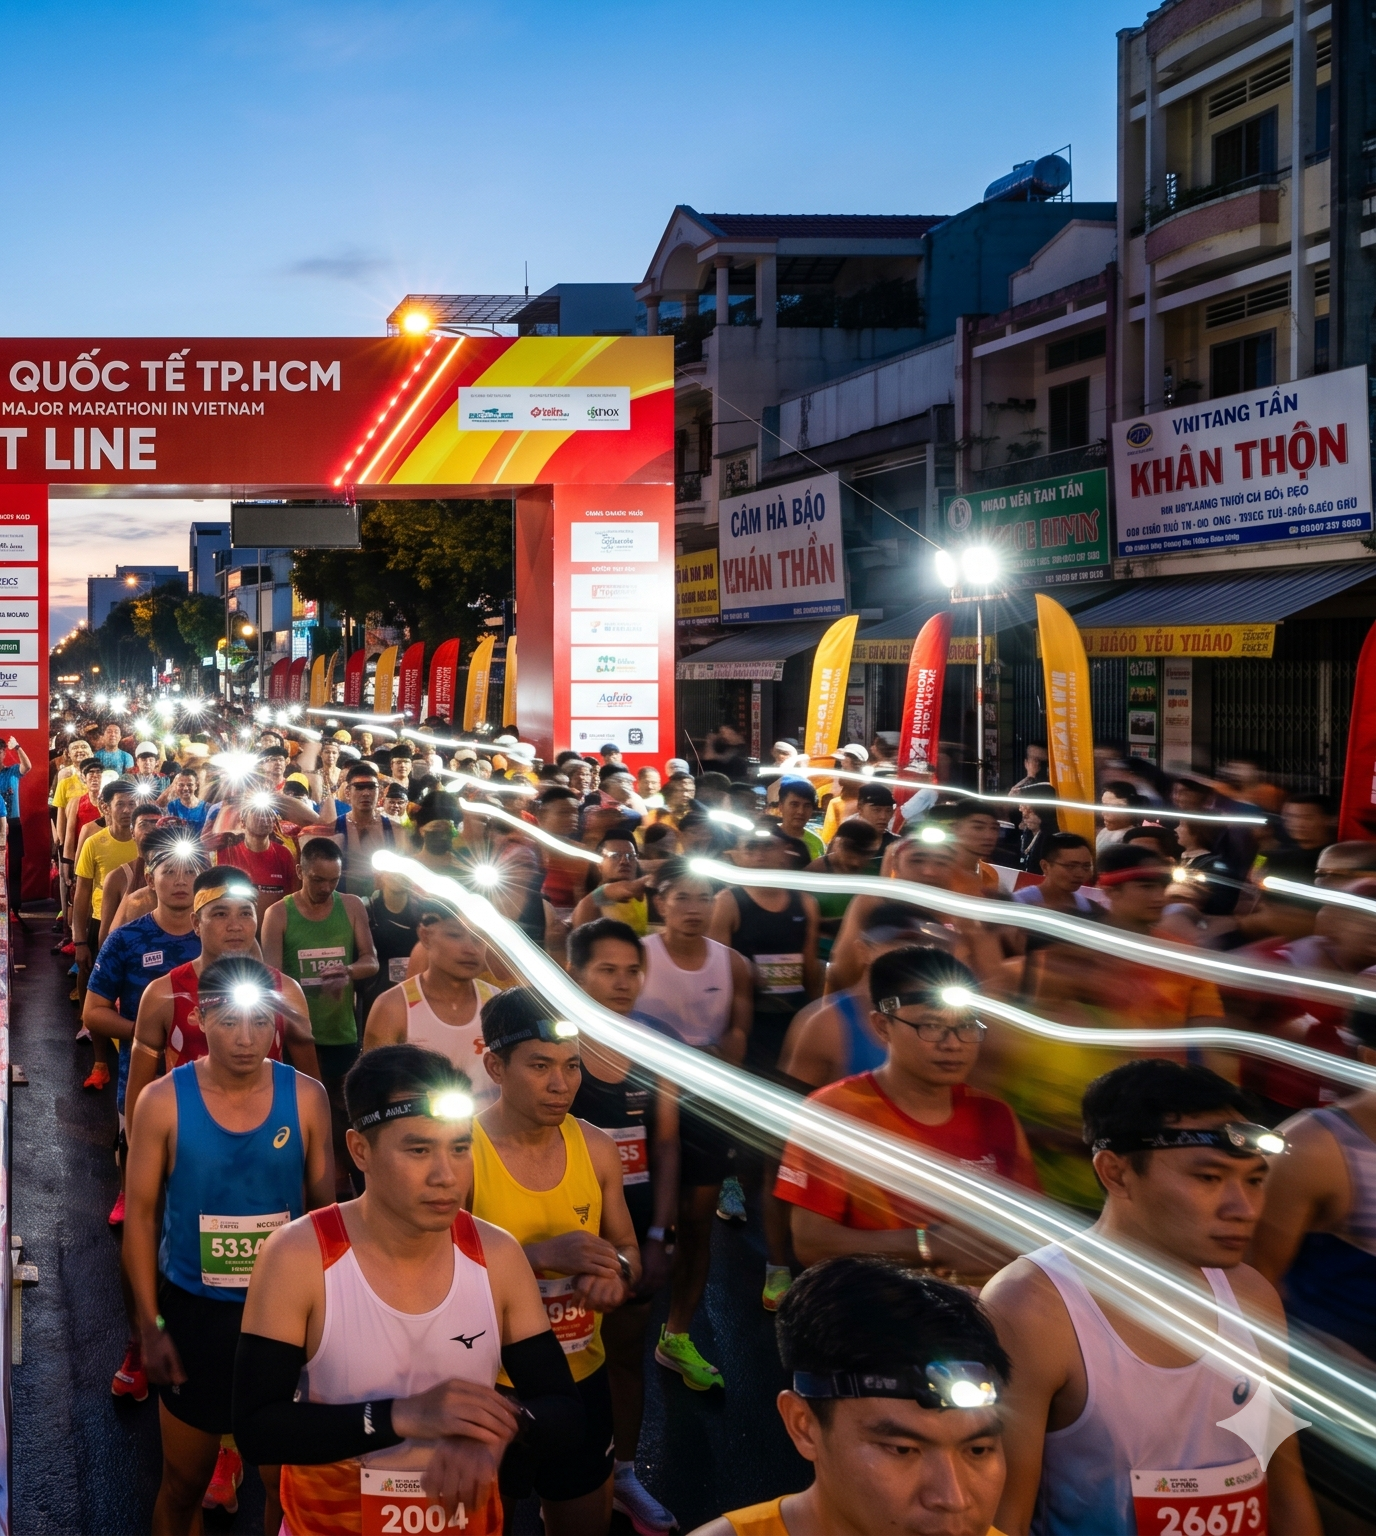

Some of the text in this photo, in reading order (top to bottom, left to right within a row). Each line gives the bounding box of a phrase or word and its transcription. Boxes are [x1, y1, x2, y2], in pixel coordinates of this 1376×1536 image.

[9, 348, 130, 393] QUỐC
[141, 348, 191, 392] TẾ
[196, 360, 341, 392] TP.HCM
[2, 401, 63, 416] MAJOR
[68, 401, 167, 416] MARATHONI
[172, 401, 188, 416] IN
[191, 401, 265, 416] VIETNAM
[45, 427, 157, 470] LINE
[1130, 420, 1348, 499] KHÂN THỘN
[730, 503, 762, 538] CÂM
[766, 494, 788, 531] HÀ
[1156, 1496, 1262, 1536] 26673
